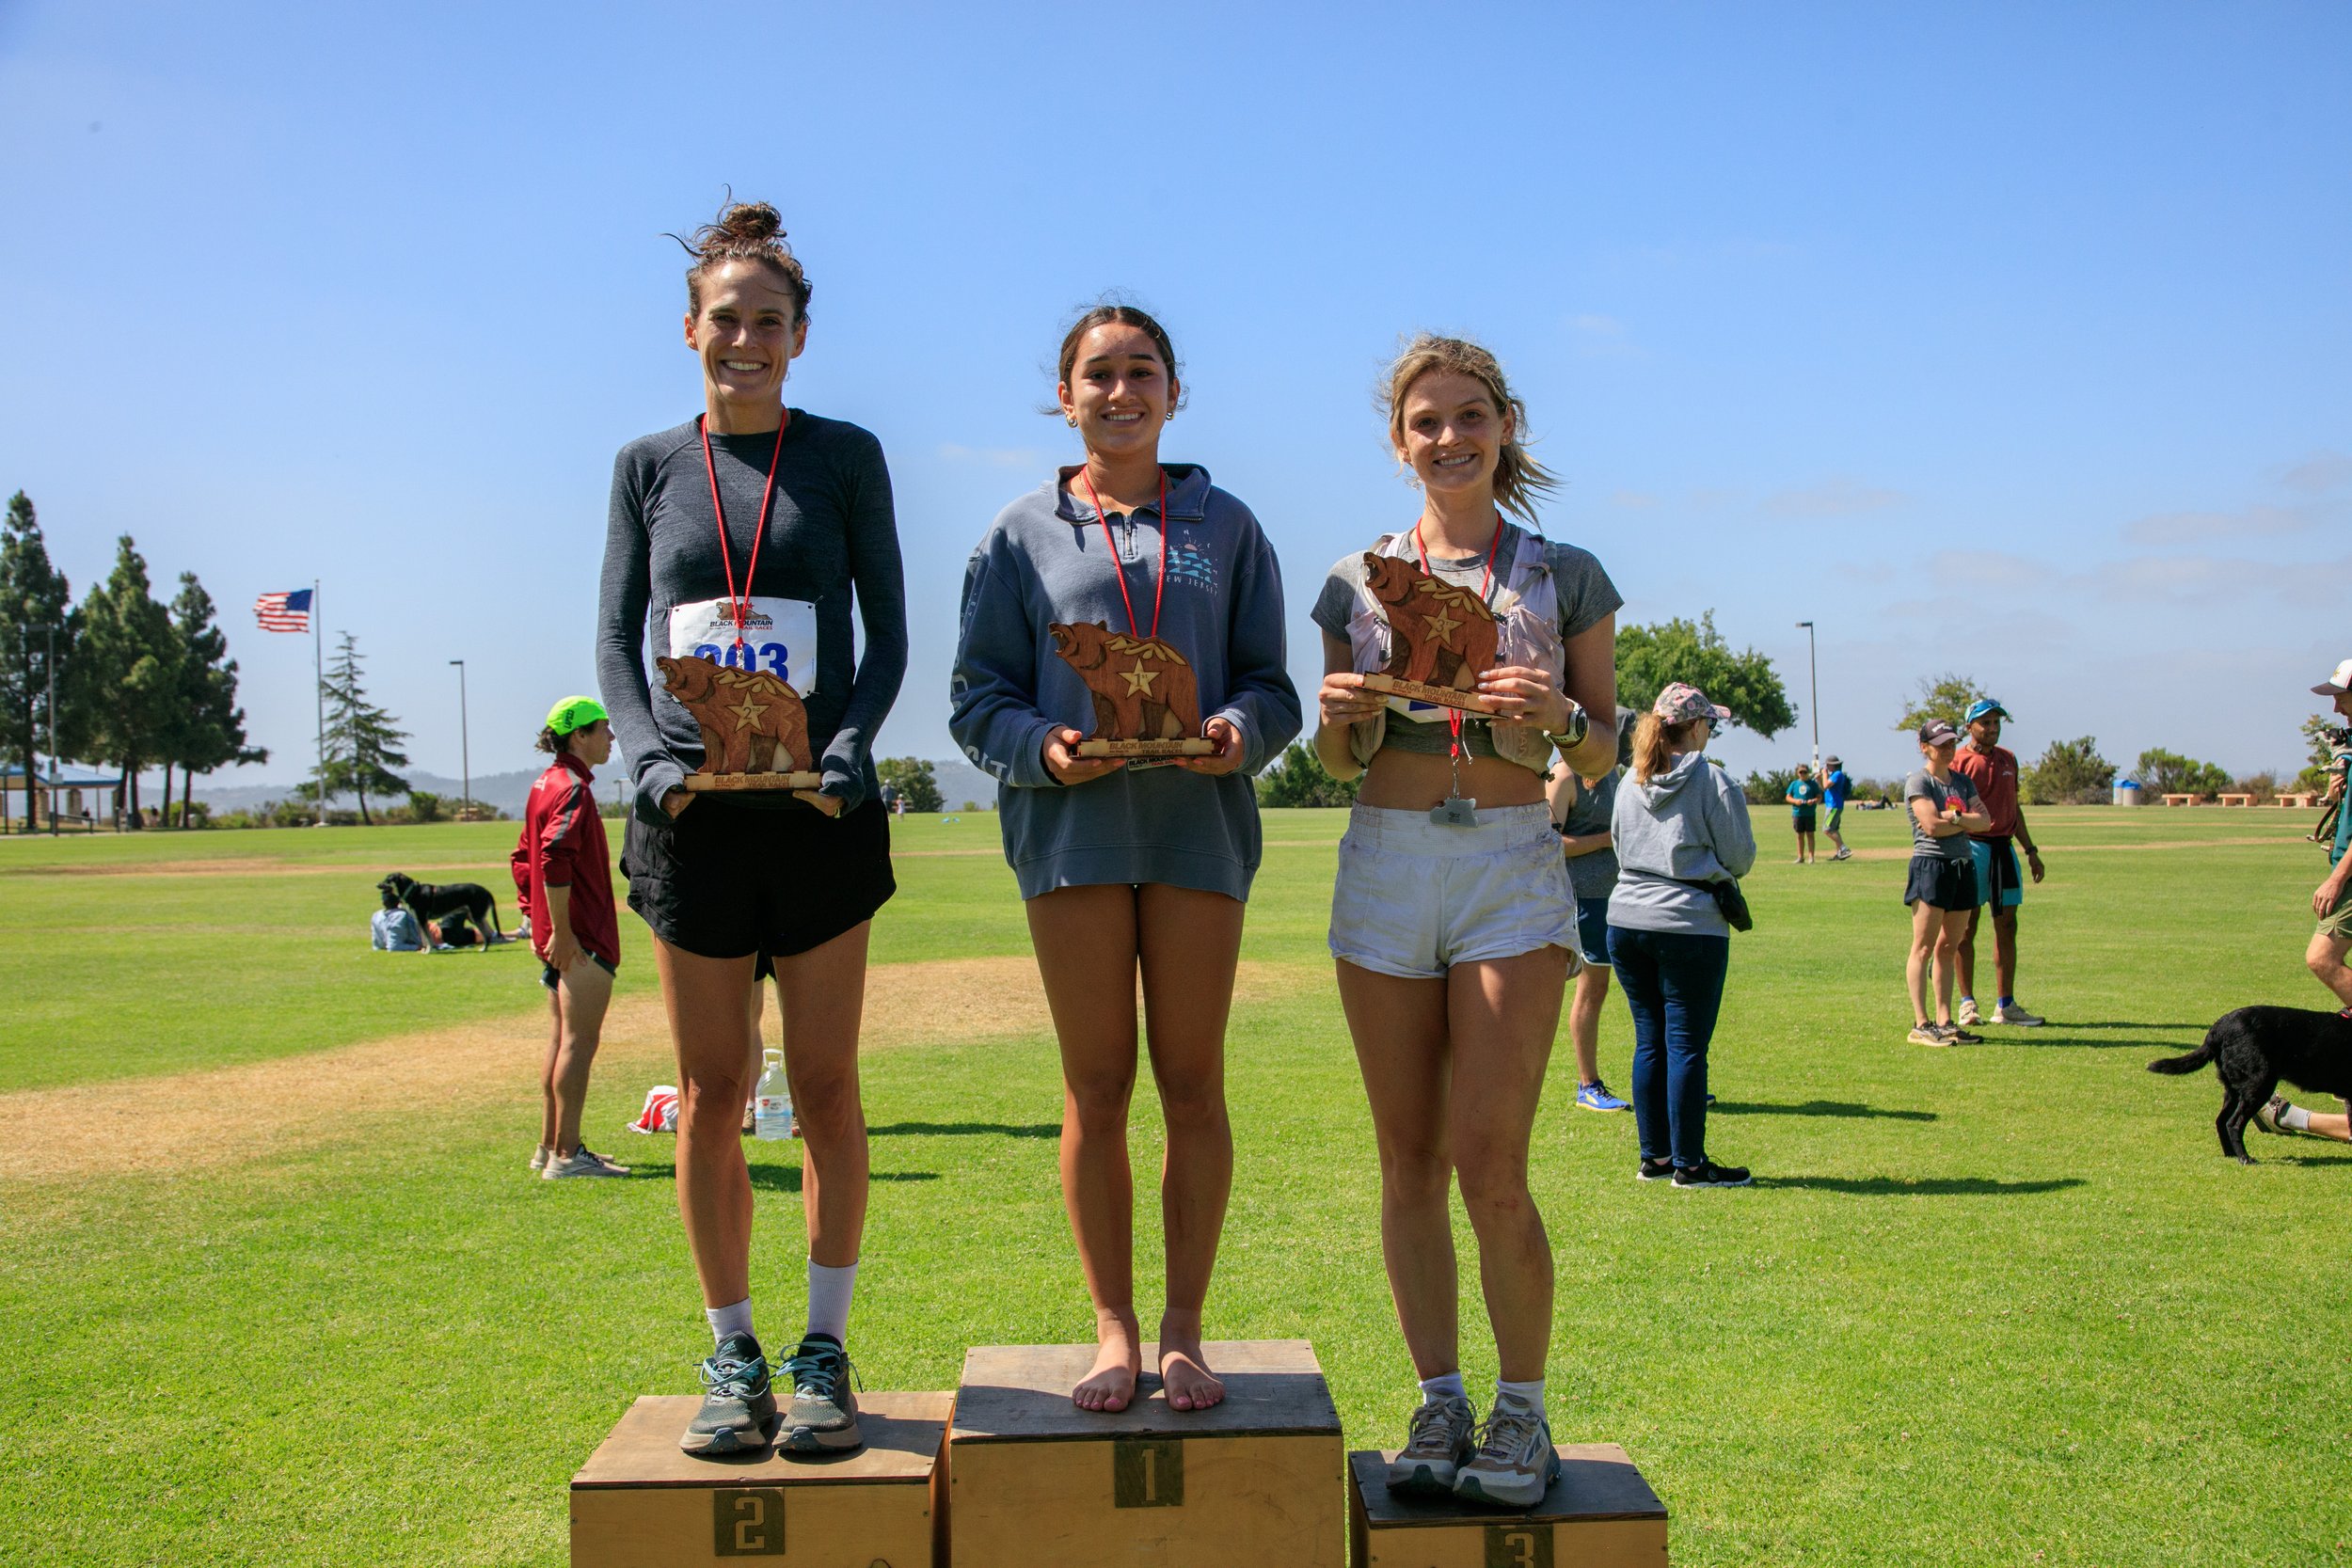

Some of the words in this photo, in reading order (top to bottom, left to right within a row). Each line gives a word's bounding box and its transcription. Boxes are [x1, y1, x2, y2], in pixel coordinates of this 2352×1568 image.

[1392, 679, 1421, 692] BLACK
[1422, 685, 1468, 701] MOUNTAIN
[1424, 694, 1443, 704] TRAIL
[1444, 698, 1466, 706] RACES
[715, 775, 745, 784] BLACK
[745, 774, 790, 783] MOUNTAIN
[1140, 1449, 1156, 1501] 1
[735, 1497, 765, 1549] 2
[1504, 1532, 1534, 1568] 3
